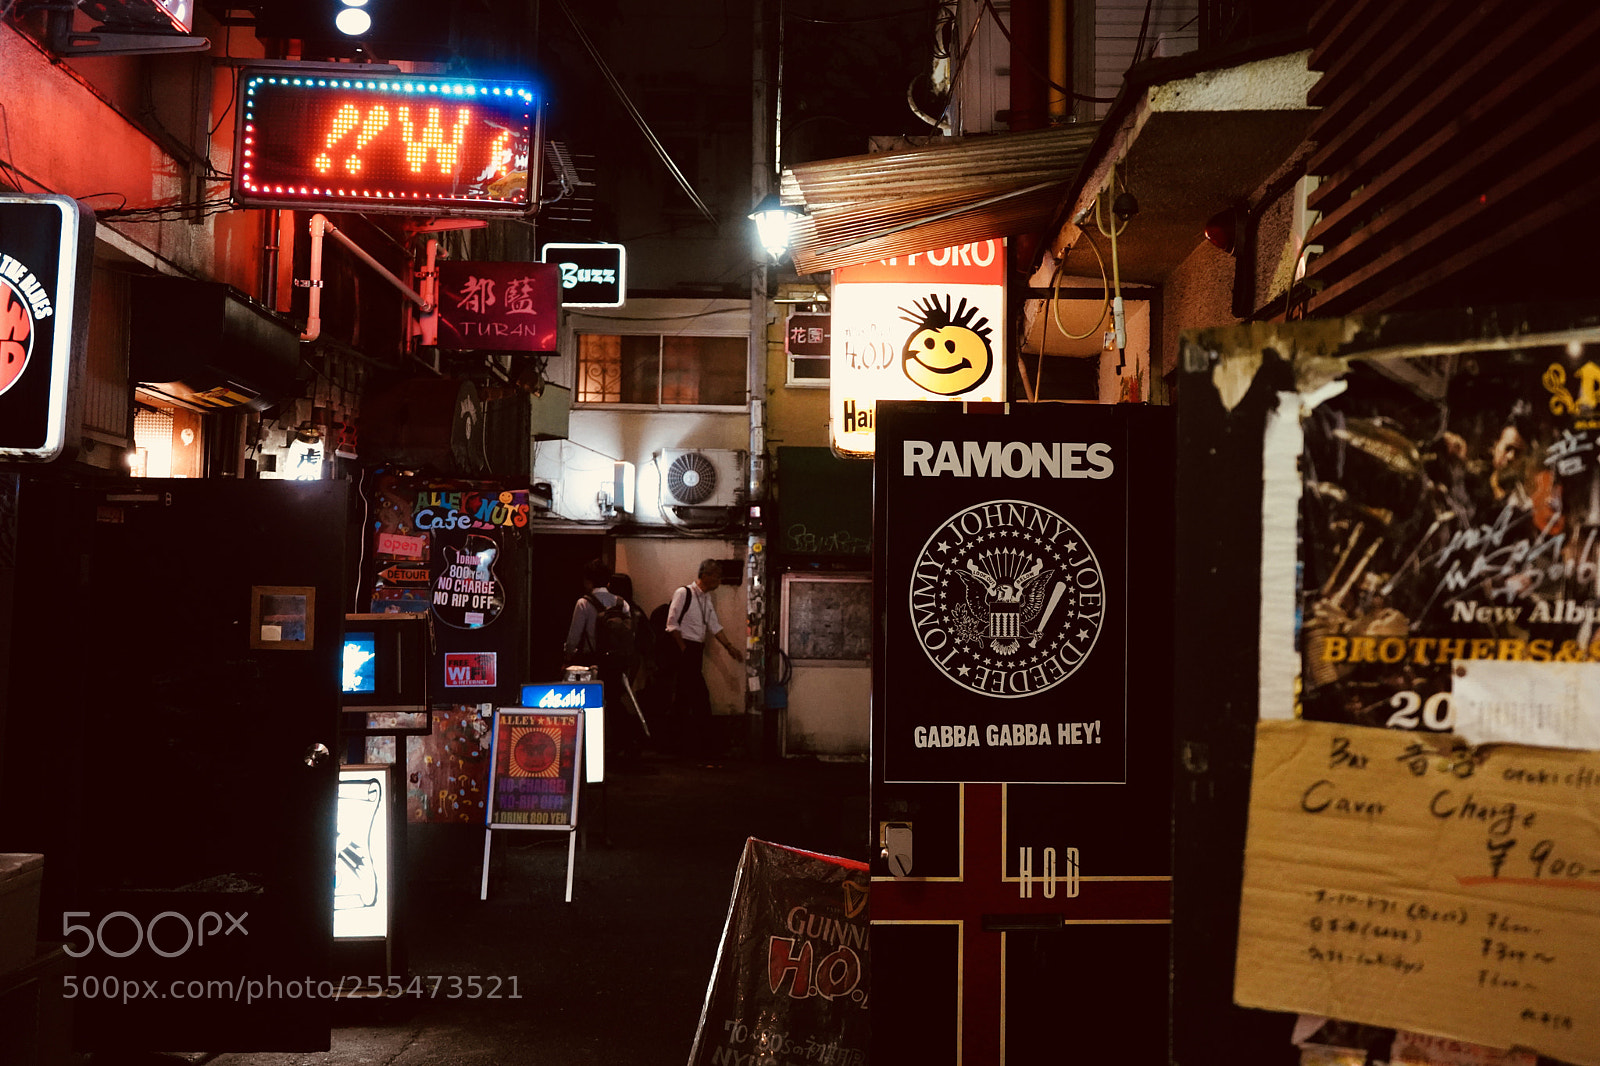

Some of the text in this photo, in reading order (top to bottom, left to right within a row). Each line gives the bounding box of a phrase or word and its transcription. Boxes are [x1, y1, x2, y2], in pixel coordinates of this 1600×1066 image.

[559, 262, 616, 289] Buzz
[18, 272, 53, 320] BLUES
[459, 322, 536, 337] TURAN
[903, 440, 1115, 480] RAMONES
[415, 509, 472, 531] Cafe
[475, 499, 530, 528] NUTS
[947, 503, 1072, 545] JOHNNY
[384, 539, 418, 552] open
[387, 569, 427, 580] DETOUR
[438, 577, 495, 595] NO CHARGE
[1068, 554, 1102, 629] JOEY
[433, 591, 495, 610] NO RIP OFF
[913, 550, 959, 672] TOMMY
[1452, 600, 1522, 623] New
[447, 666, 487, 681] WiFi
[448, 659, 470, 667] FREE
[539, 688, 586, 708] Asahi
[499, 715, 576, 726] ALLEY NUTS
[914, 720, 1101, 748] GABBA GABBA HEY!
[500, 812, 530, 824] DRINK
[530, 812, 549, 824] 800
[551, 812, 568, 824] YEN
[1430, 789, 1536, 836] Charge
[767, 935, 869, 1010] H.O.
